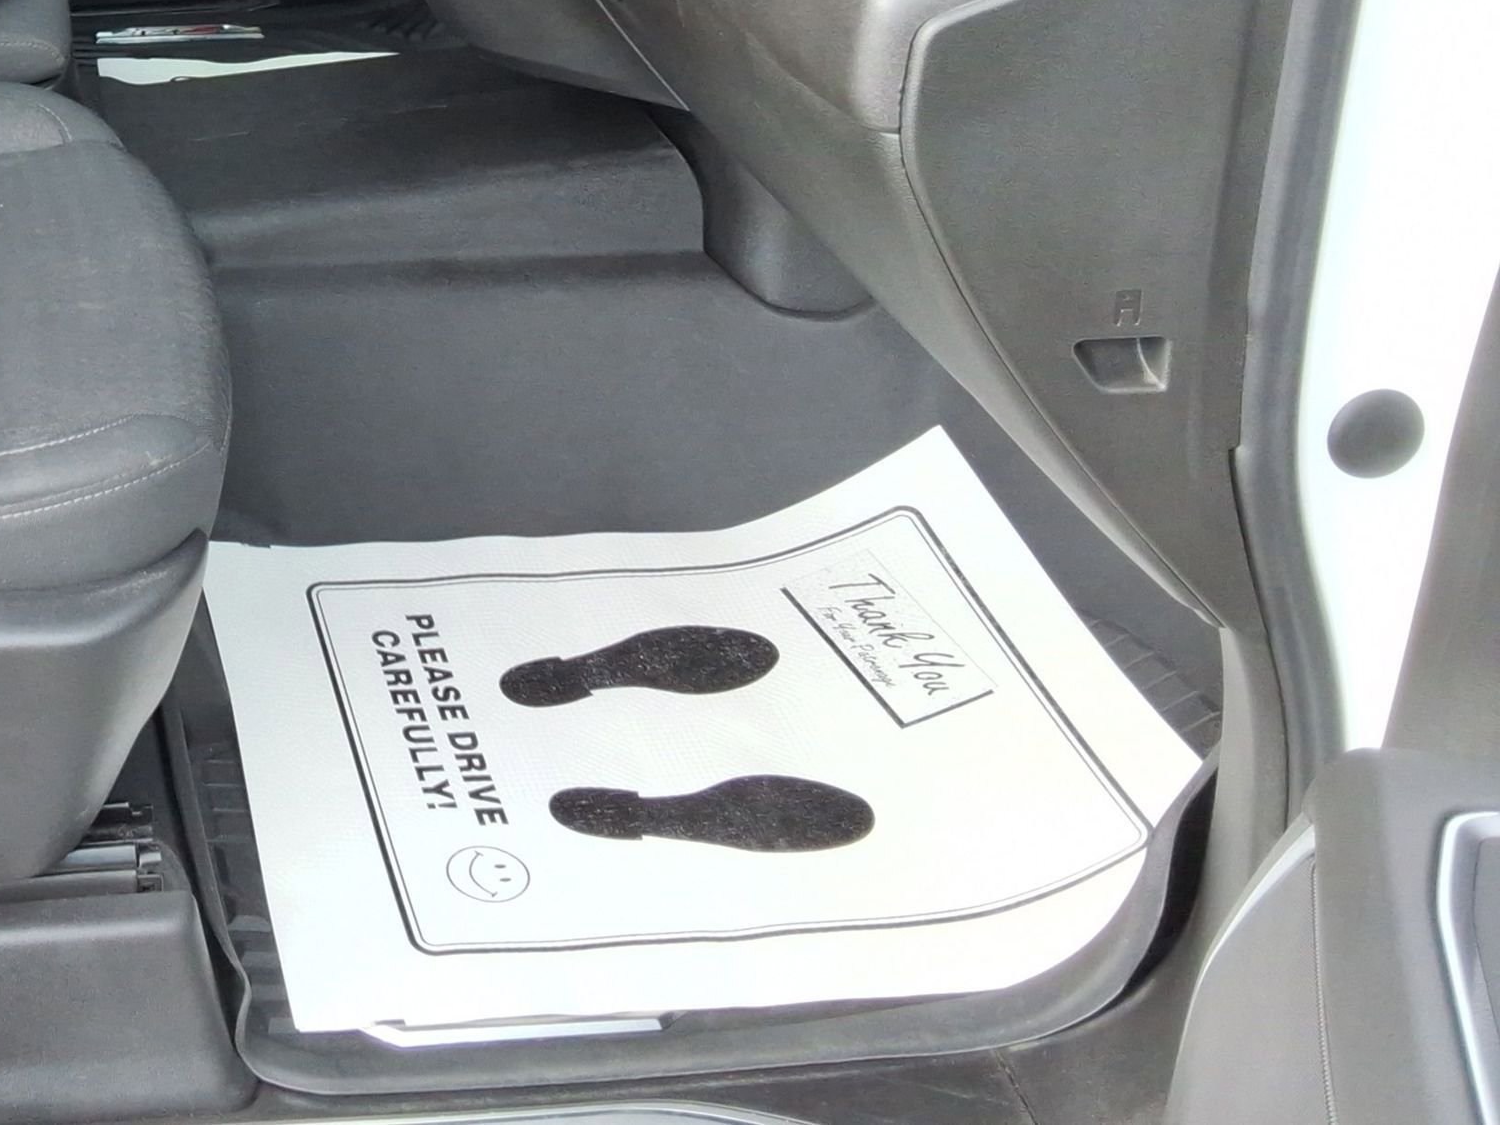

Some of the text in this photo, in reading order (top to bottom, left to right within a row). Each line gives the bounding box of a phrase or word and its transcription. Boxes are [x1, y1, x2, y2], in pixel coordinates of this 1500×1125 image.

[371, 630, 458, 809] CAREFULLY!
[405, 614, 509, 826] PLEASE DRIVE
[828, 573, 965, 696] Thank You
